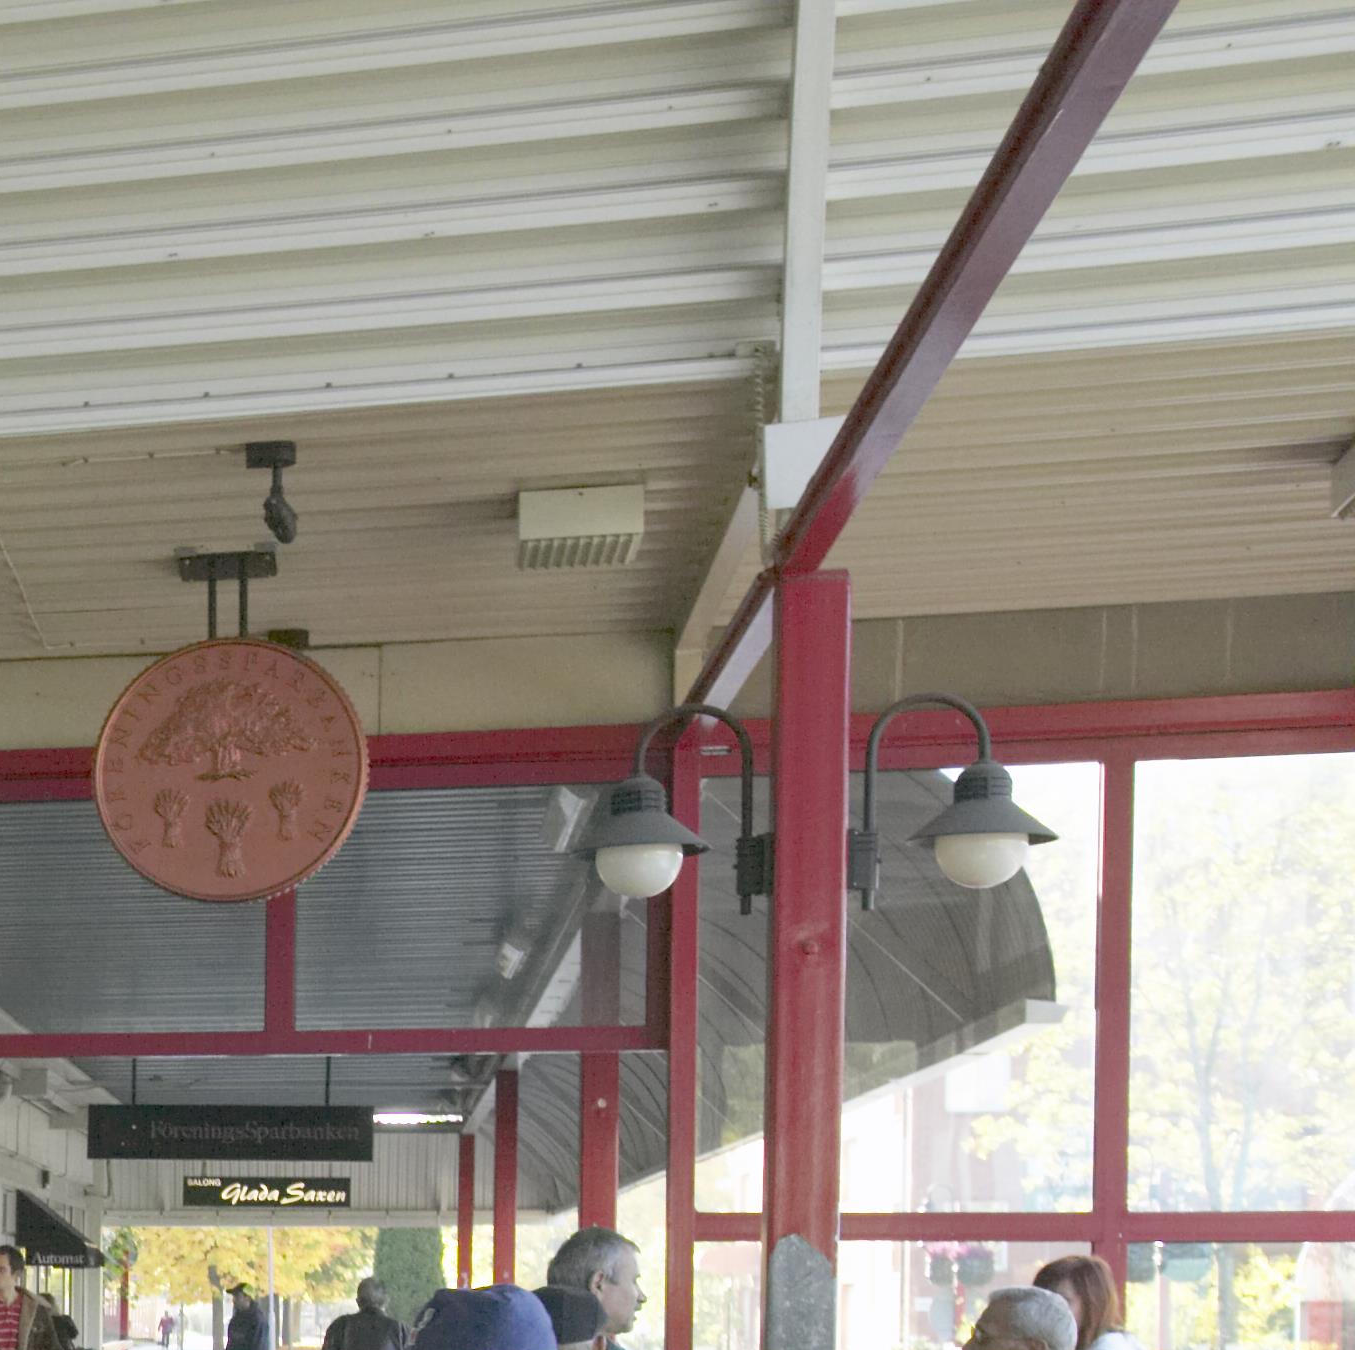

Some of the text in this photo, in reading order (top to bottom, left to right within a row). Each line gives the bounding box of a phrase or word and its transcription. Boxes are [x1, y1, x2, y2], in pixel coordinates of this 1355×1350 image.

[186, 1177, 222, 1187] SALONG
[221, 1182, 346, 1205] Glada Saxen
[32, 1252, 85, 1265] Automat
